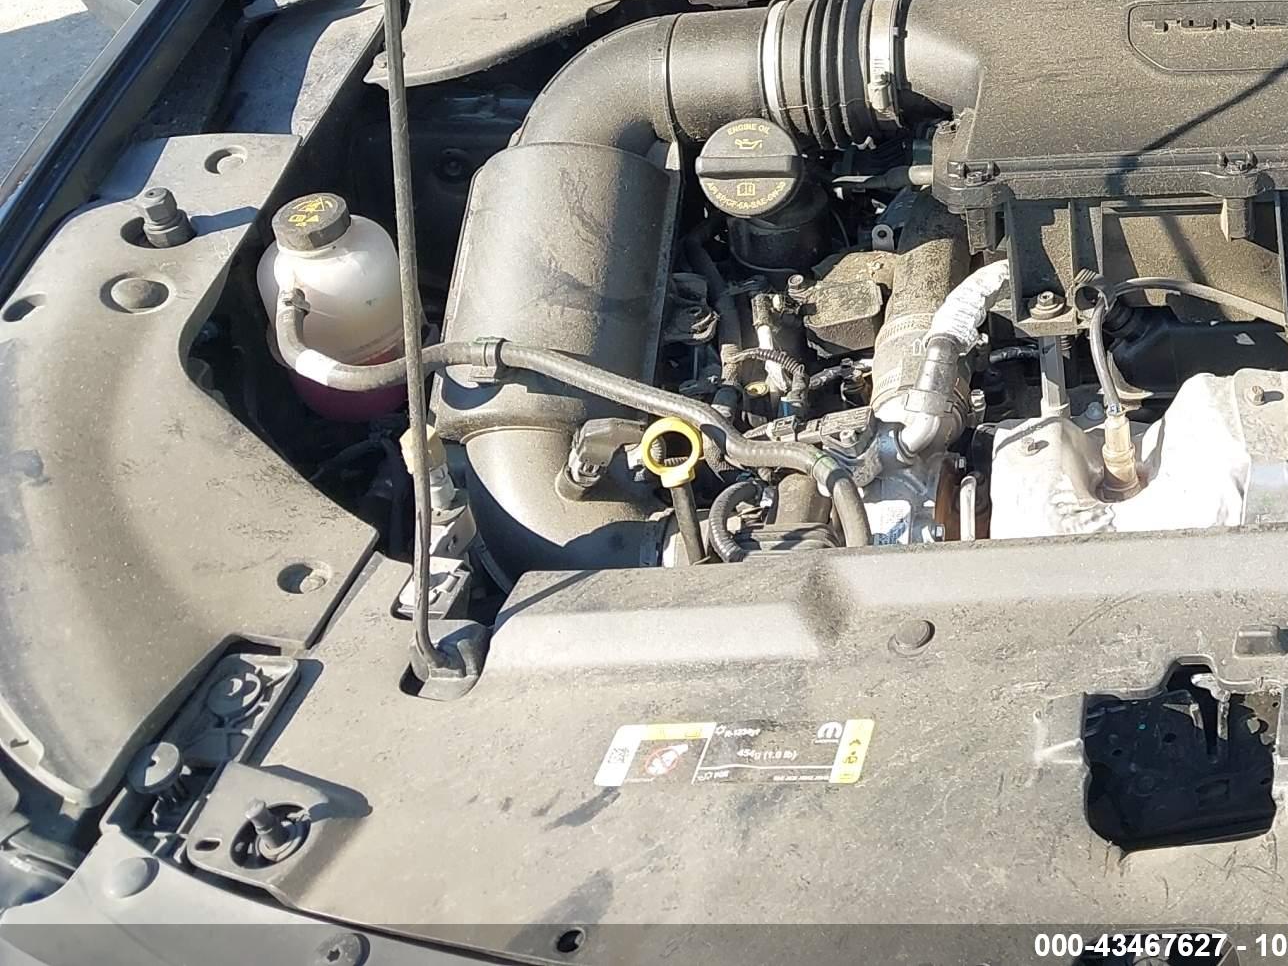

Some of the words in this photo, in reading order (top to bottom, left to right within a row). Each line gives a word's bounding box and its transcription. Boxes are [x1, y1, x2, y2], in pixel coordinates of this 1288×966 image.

[727, 123, 757, 136] ENGINE
[758, 124, 770, 137] OIL
[736, 748, 761, 760] 454g
